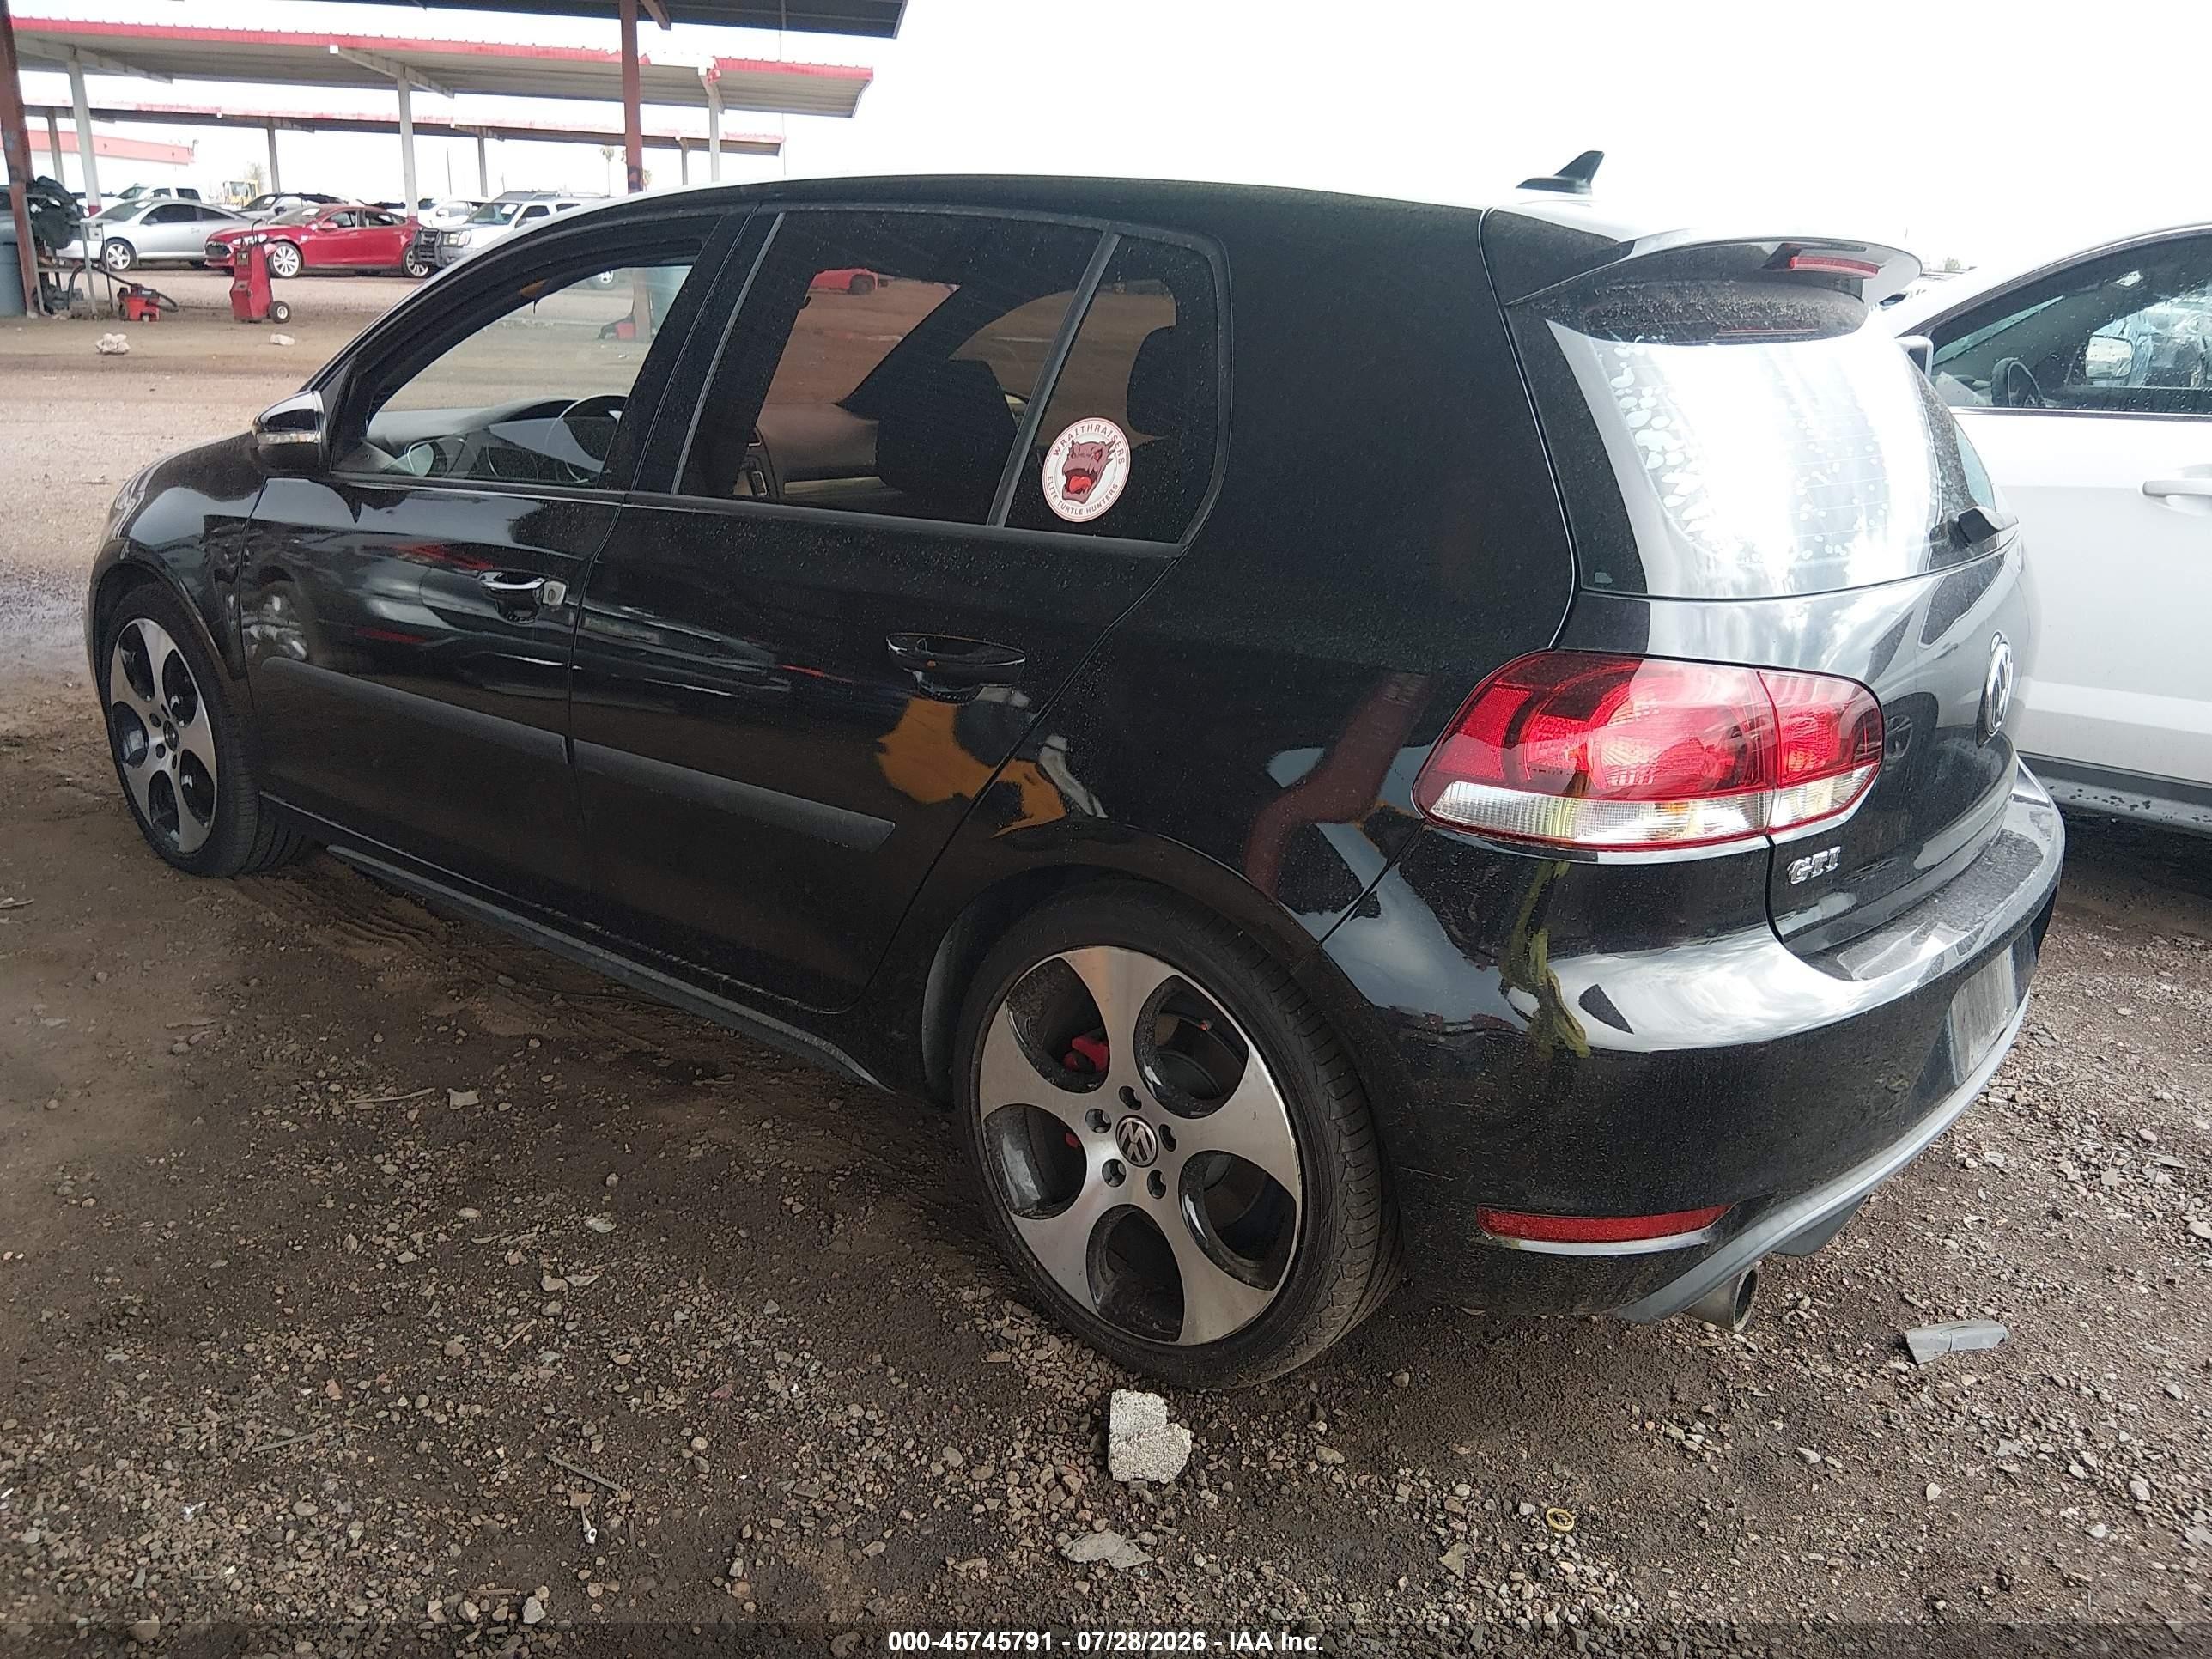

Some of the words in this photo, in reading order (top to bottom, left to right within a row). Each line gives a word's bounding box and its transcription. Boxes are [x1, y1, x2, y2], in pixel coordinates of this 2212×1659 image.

[1053, 424, 1125, 465] WRAITHRAISERS
[1048, 476, 1059, 501] ELITE
[1057, 500, 1083, 515] TURTLE
[1086, 484, 1118, 514] HUNTERS
[1787, 846, 1841, 884] GTI
